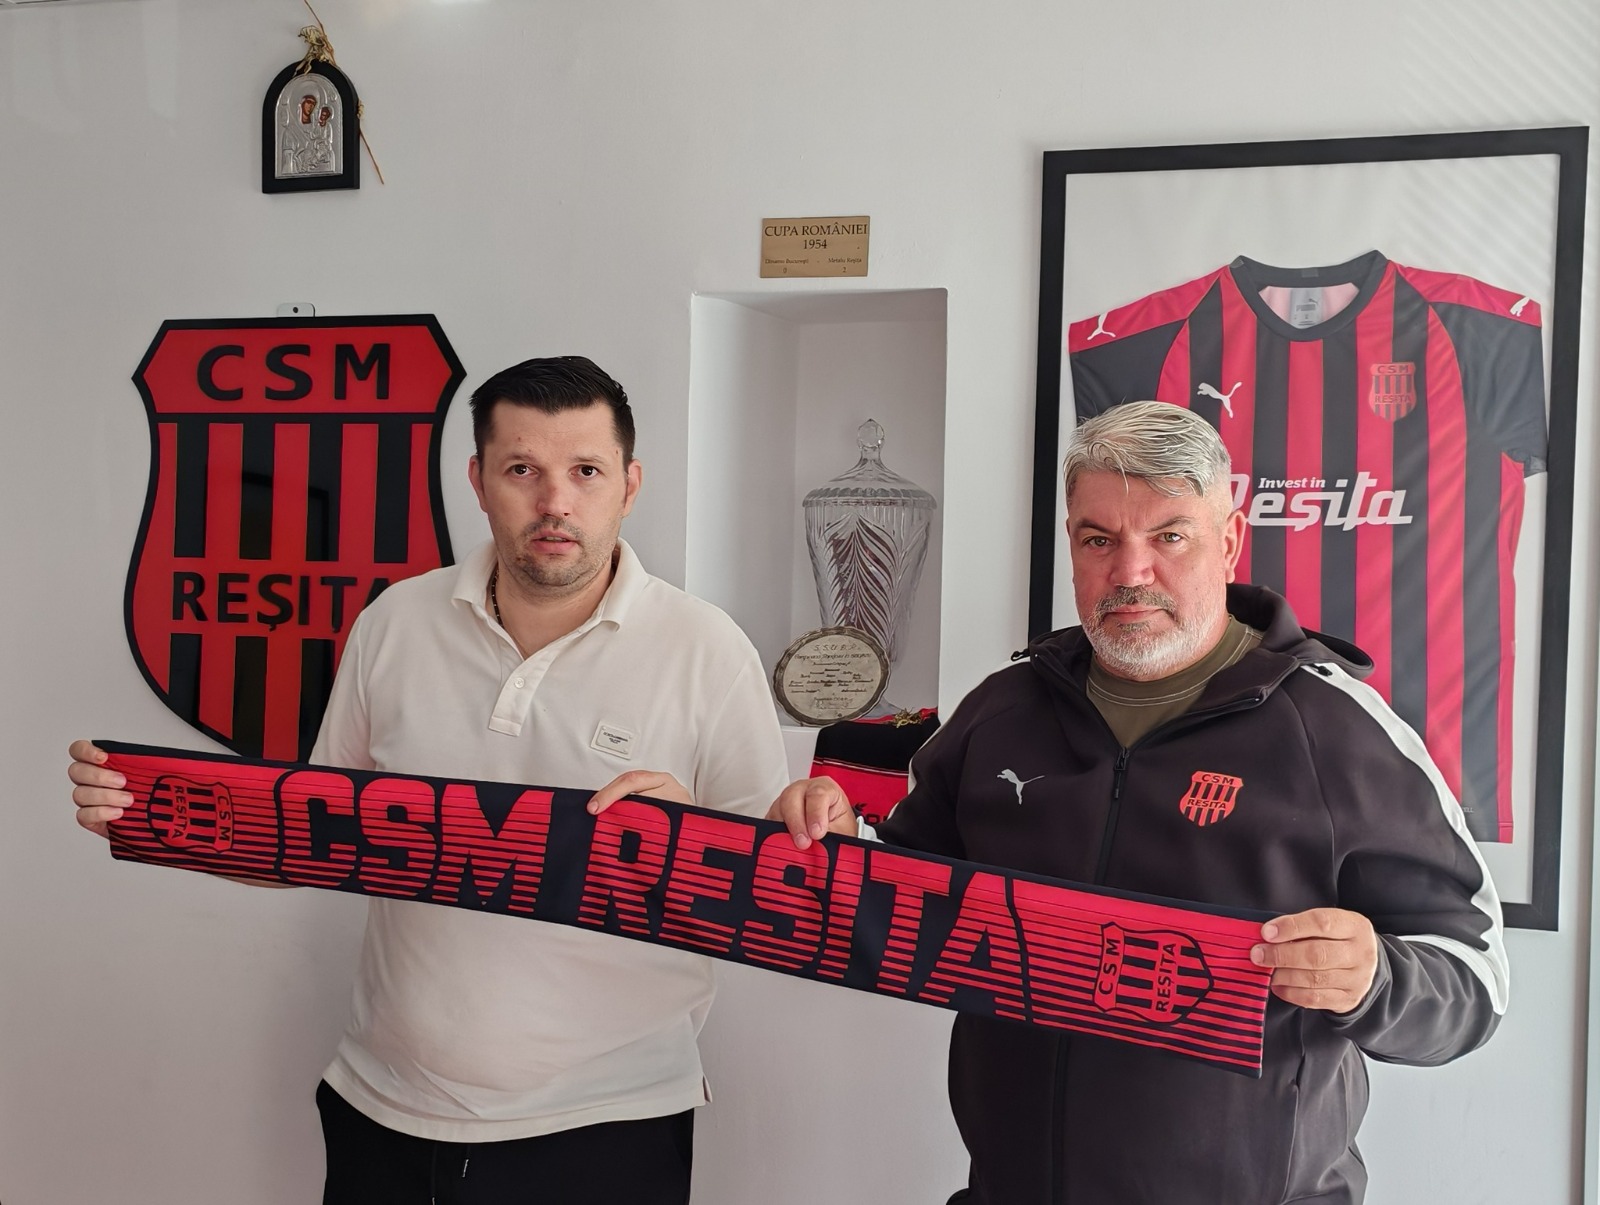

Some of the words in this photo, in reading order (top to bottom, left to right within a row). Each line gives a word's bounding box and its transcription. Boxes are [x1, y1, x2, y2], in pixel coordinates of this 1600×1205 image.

[764, 225, 799, 237] CUPA
[802, 221, 868, 236] ROMÂNIEI
[803, 239, 827, 250] 1954
[196, 343, 391, 401] CSM
[1377, 365, 1409, 374] CSM
[1258, 477, 1308, 488] Invest
[1309, 477, 1326, 488] in
[1201, 774, 1235, 785] CSM
[217, 795, 231, 841] CSM
[280, 770, 554, 913] CSM
[1098, 938, 1121, 996] CSM
